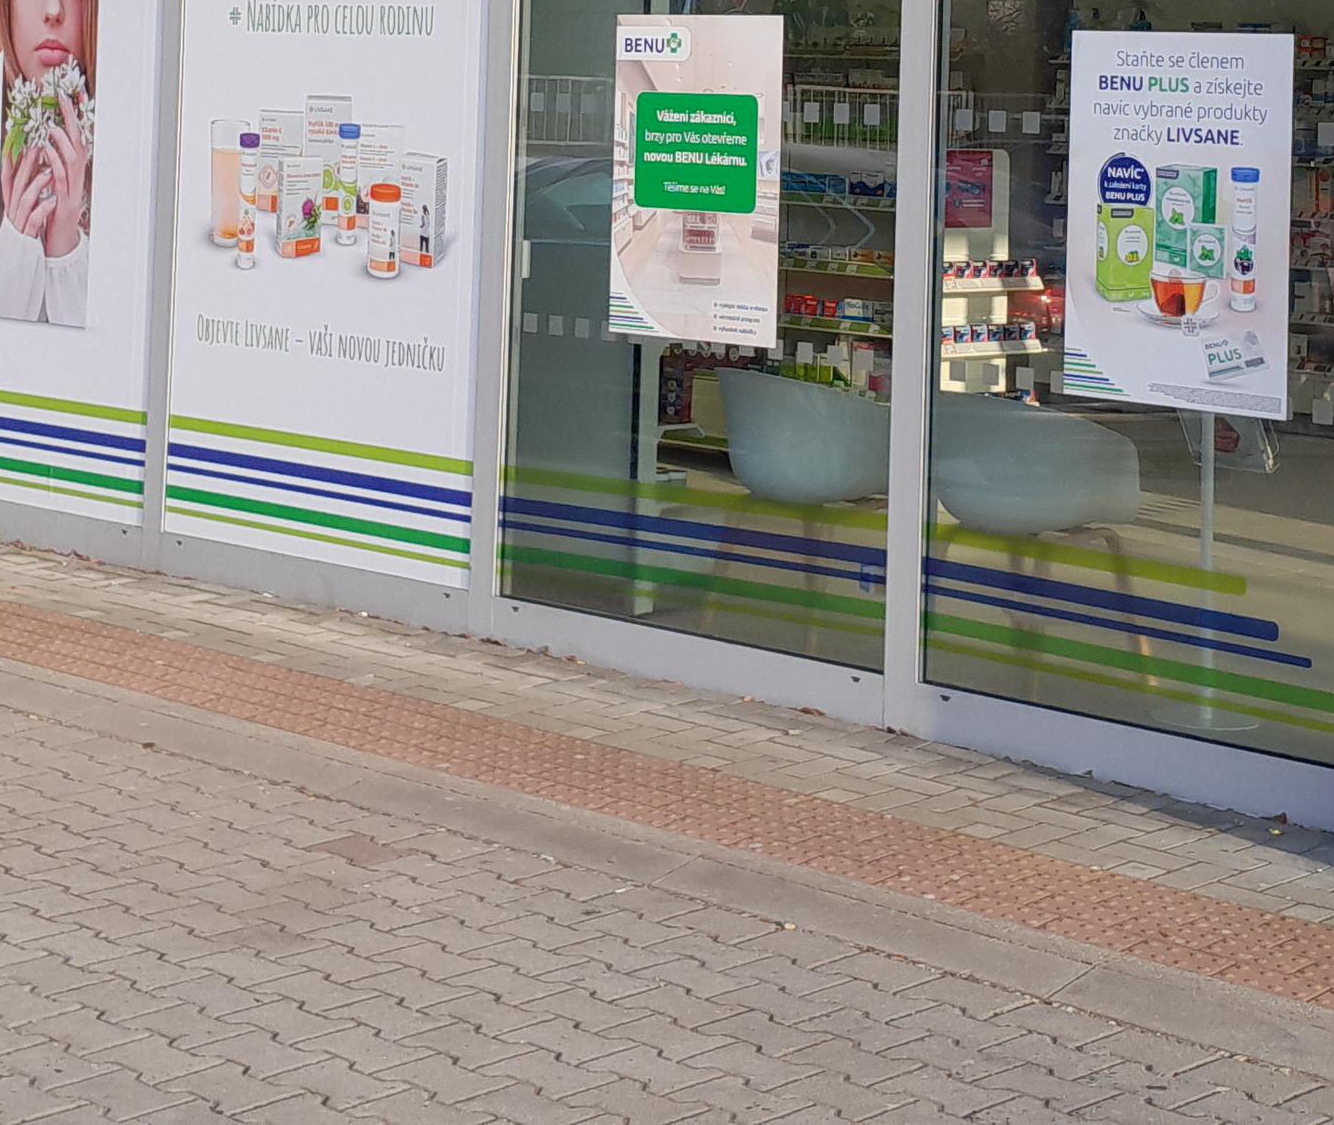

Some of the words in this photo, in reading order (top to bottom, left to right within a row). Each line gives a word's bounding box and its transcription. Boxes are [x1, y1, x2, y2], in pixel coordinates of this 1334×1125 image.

[624, 37, 665, 53] BENU
[1116, 50, 1165, 68] Staňte
[1168, 54, 1184, 69] se
[1189, 51, 1244, 69] členem
[1098, 75, 1143, 91] BENU
[1148, 76, 1189, 93] PLUS
[1194, 82, 1201, 94] a
[1206, 78, 1263, 98] získejte
[1093, 99, 1130, 116] navíc
[1134, 100, 1193, 120] vybrané
[1197, 103, 1267, 125] produkty
[645, 129, 664, 144] brzy
[666, 133, 682, 144] pro
[684, 131, 700, 143] Vás
[701, 132, 747, 145] otevřeme
[1113, 125, 1163, 145] značky
[1167, 127, 1243, 146] LIVSANE.
[644, 152, 673, 163] novou
[675, 151, 703, 163] BENU
[700, 186, 709, 194] na
[1105, 191, 1125, 200] BENU
[1127, 192, 1145, 201] PLUS
[1208, 348, 1242, 365] PLUS
